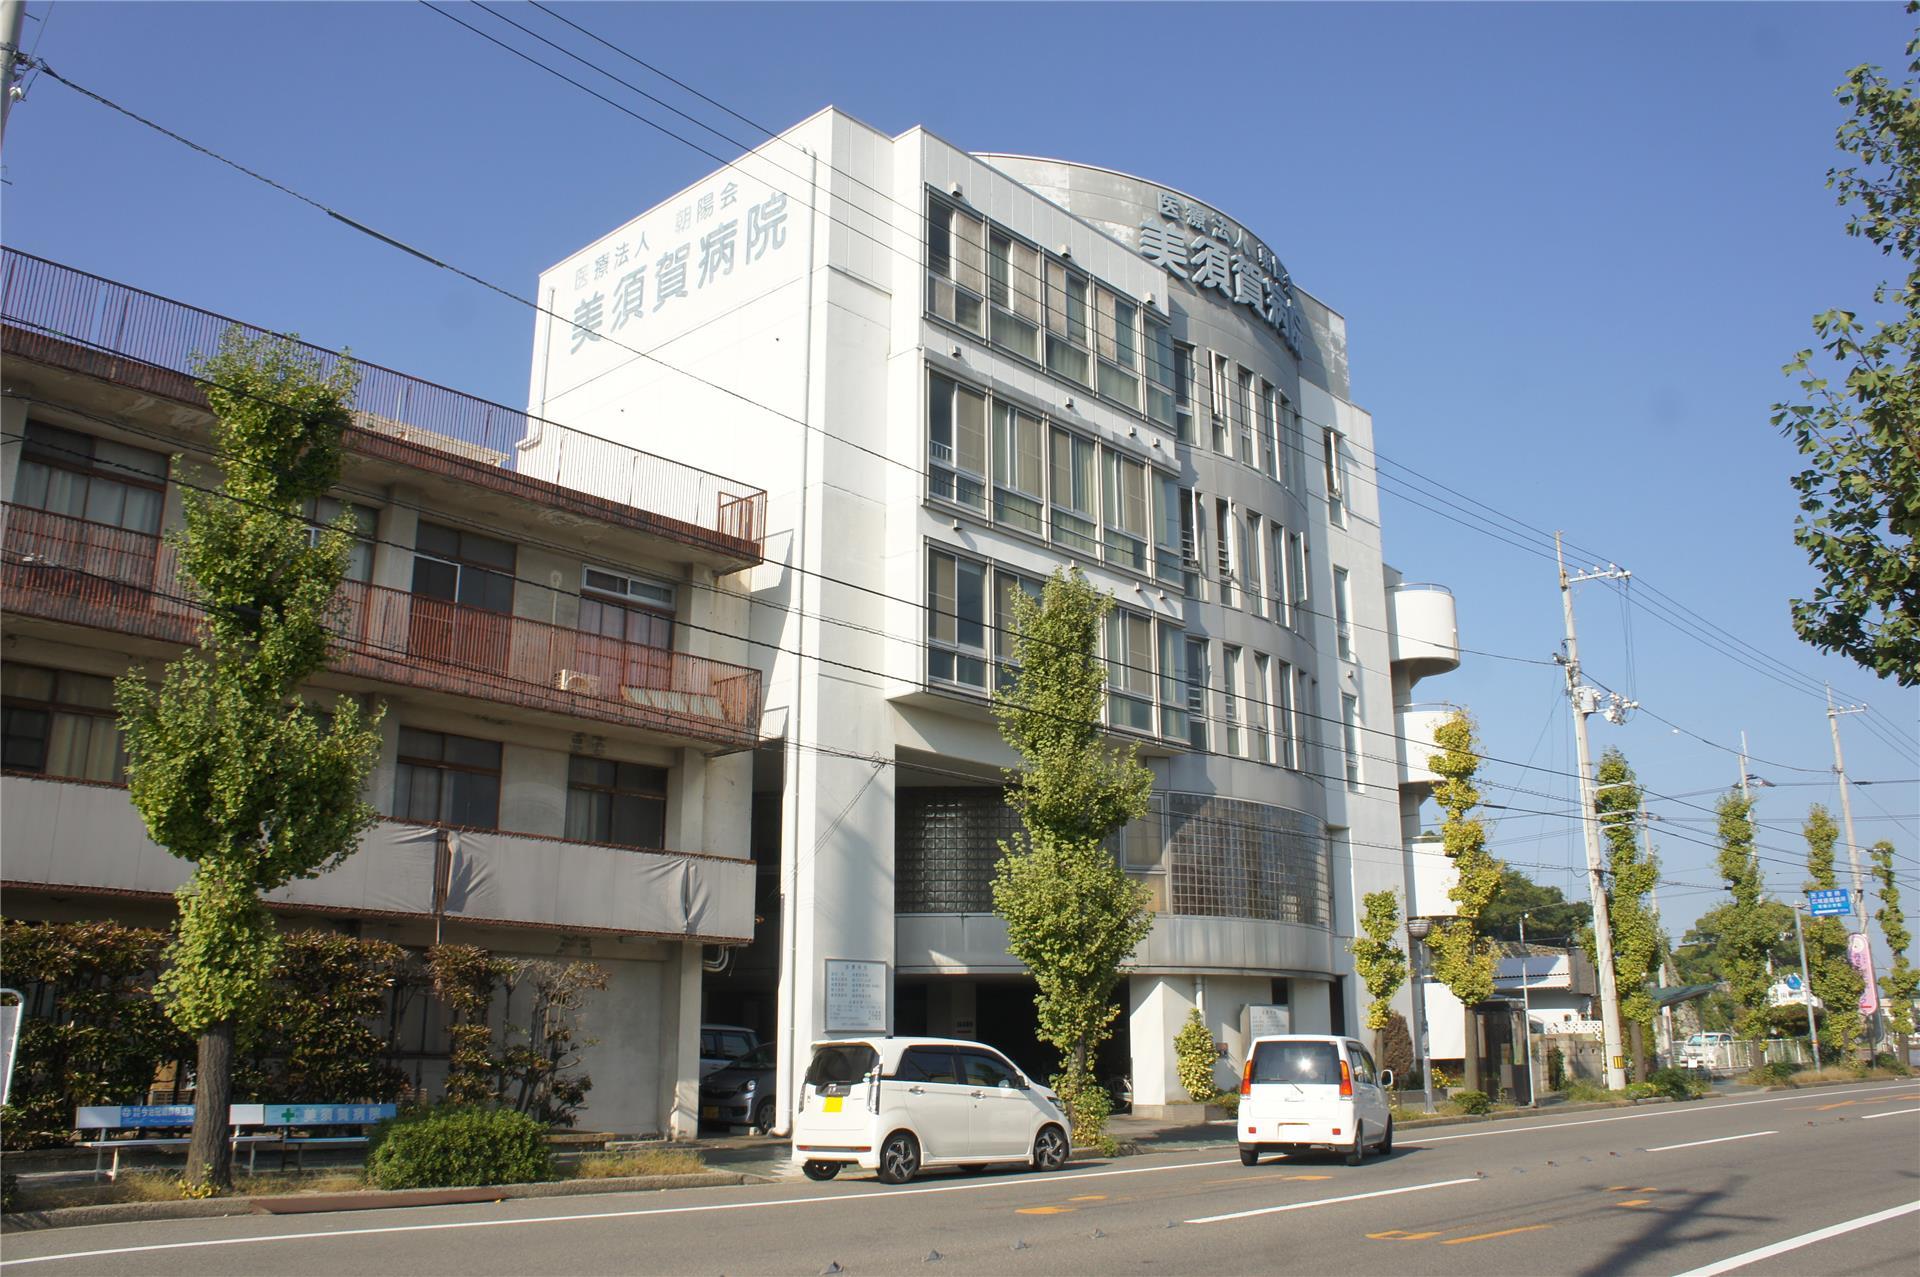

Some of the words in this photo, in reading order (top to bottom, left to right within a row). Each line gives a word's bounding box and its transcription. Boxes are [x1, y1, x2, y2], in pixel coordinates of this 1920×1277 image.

[570, 192, 788, 355] 美須賀病院
[1158, 192, 1249, 256] 医療法人
